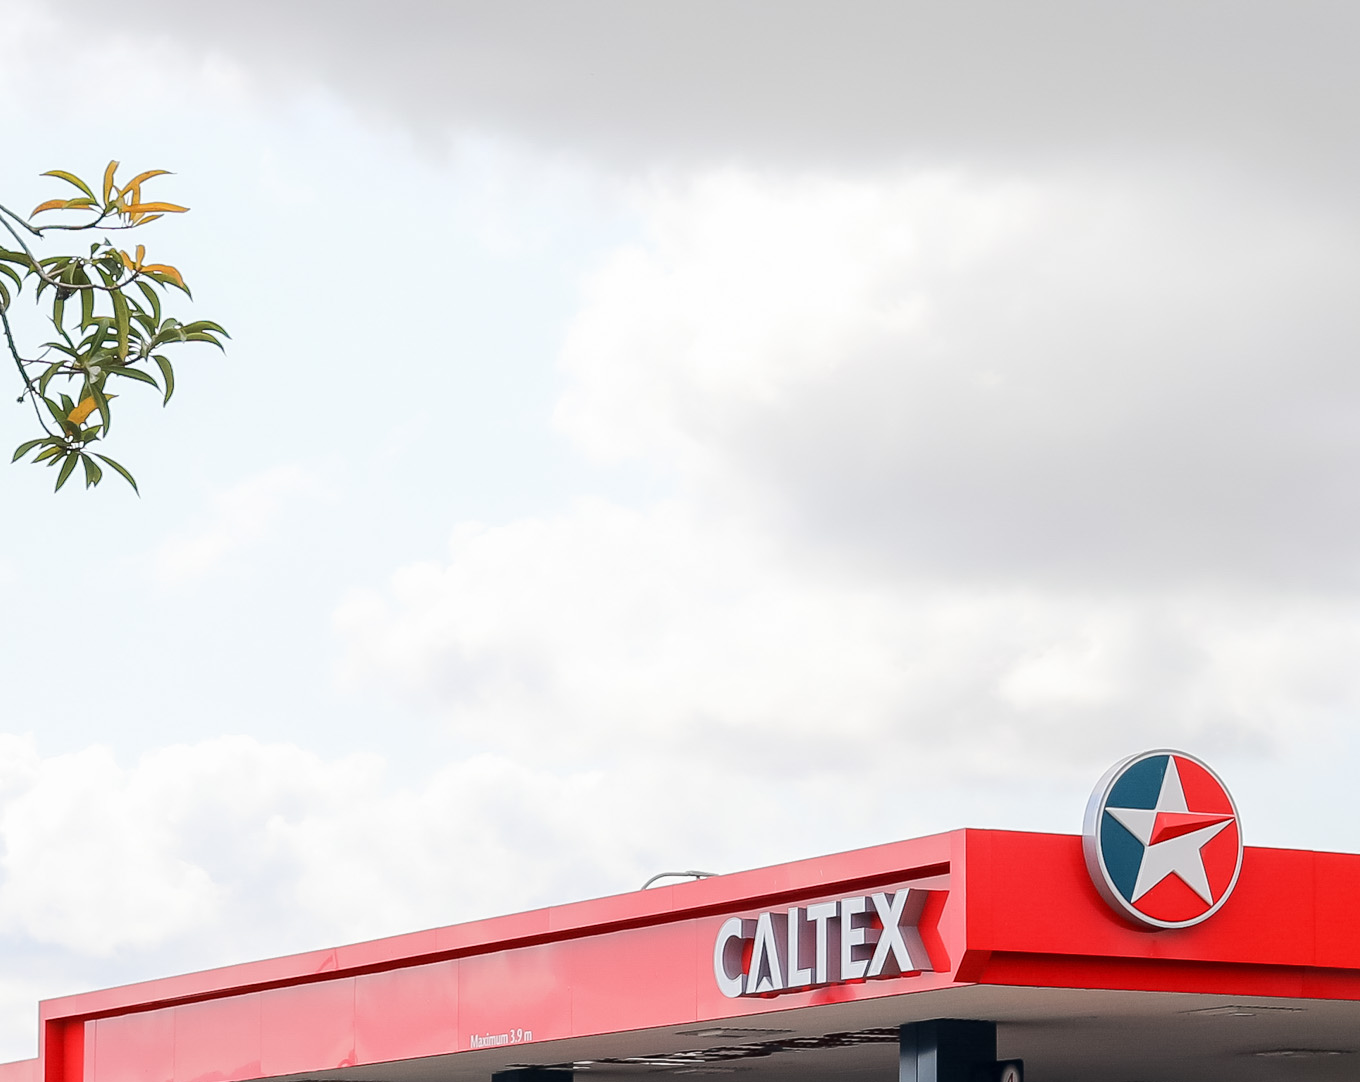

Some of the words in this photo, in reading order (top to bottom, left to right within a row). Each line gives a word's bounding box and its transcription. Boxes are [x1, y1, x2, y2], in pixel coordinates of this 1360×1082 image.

[713, 888, 916, 998] CALTEX
[470, 1032, 509, 1049] Maximum
[509, 1028, 523, 1044] 3.9
[523, 1030, 533, 1042] m
